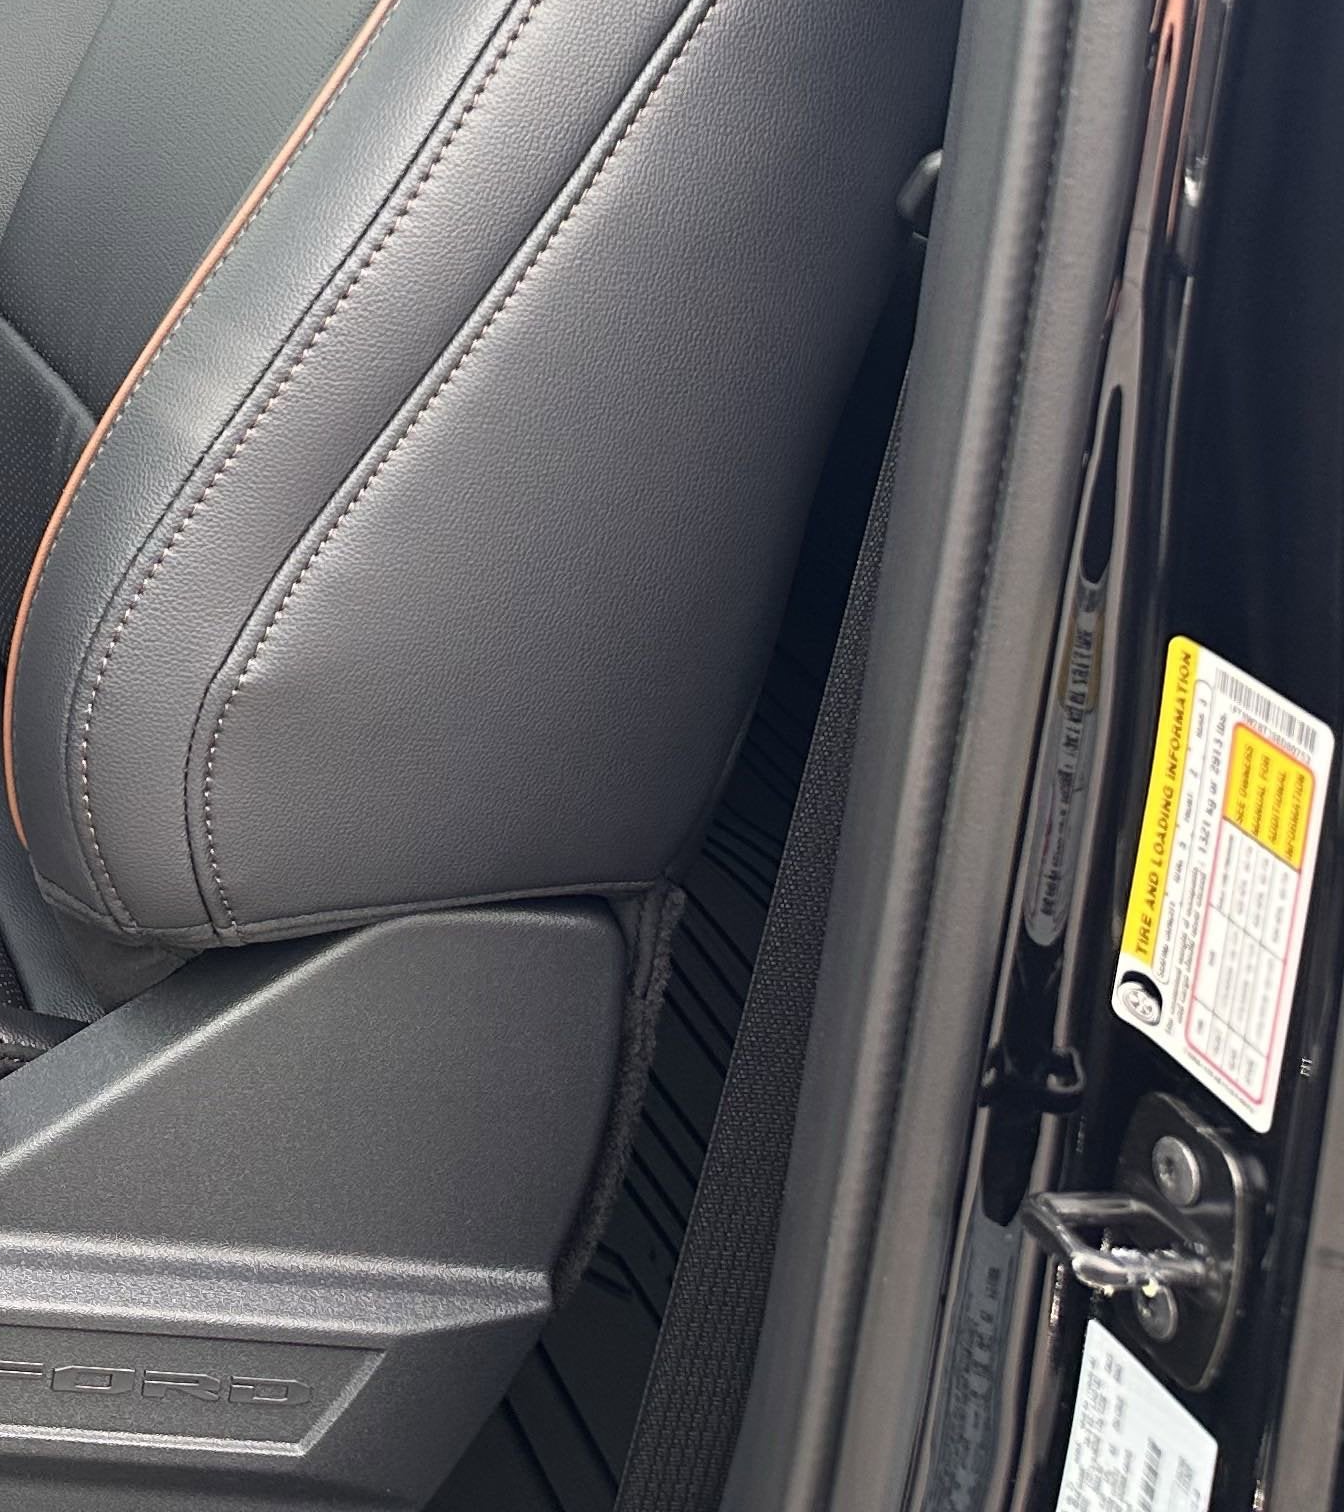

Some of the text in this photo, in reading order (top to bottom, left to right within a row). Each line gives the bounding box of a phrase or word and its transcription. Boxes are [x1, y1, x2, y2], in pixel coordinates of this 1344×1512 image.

[1211, 738, 1224, 775] 2913
[1135, 651, 1192, 956] TIRE AND LOADING INFORMATION
[1207, 800, 1217, 818] kg
[1252, 786, 1266, 839] MANUAL
[1268, 771, 1287, 844] ADDITIONAL
[1287, 774, 1306, 860] INFORMATION
